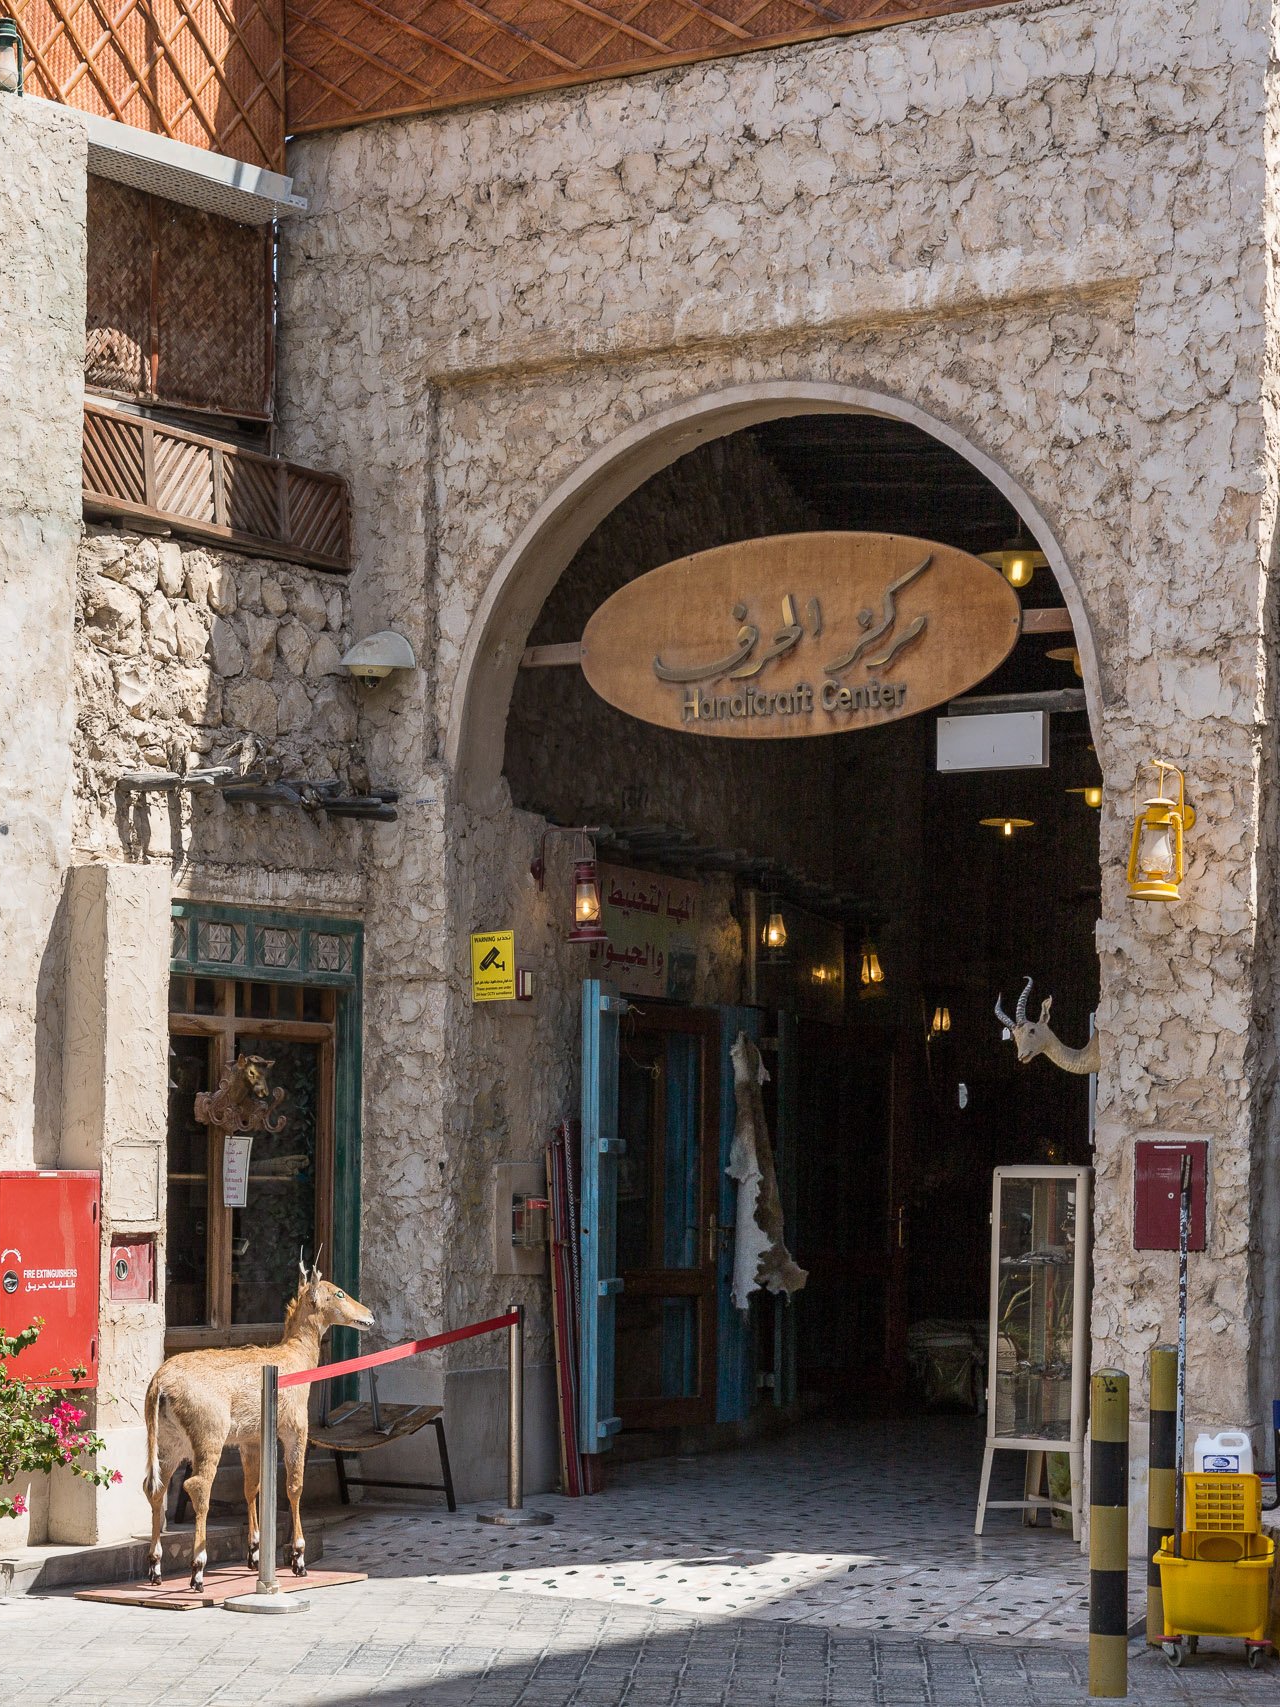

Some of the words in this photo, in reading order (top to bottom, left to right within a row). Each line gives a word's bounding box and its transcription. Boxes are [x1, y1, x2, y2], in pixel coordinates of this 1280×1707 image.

[823, 554, 934, 675] مركز
[653, 593, 821, 683] الحرف
[682, 683, 814, 722] Handicraft
[821, 679, 908, 713] Center
[24, 1269, 36, 1278] FIRE
[36, 1269, 77, 1278] EXTINGUISHERS
[24, 1281, 47, 1292] حريق
